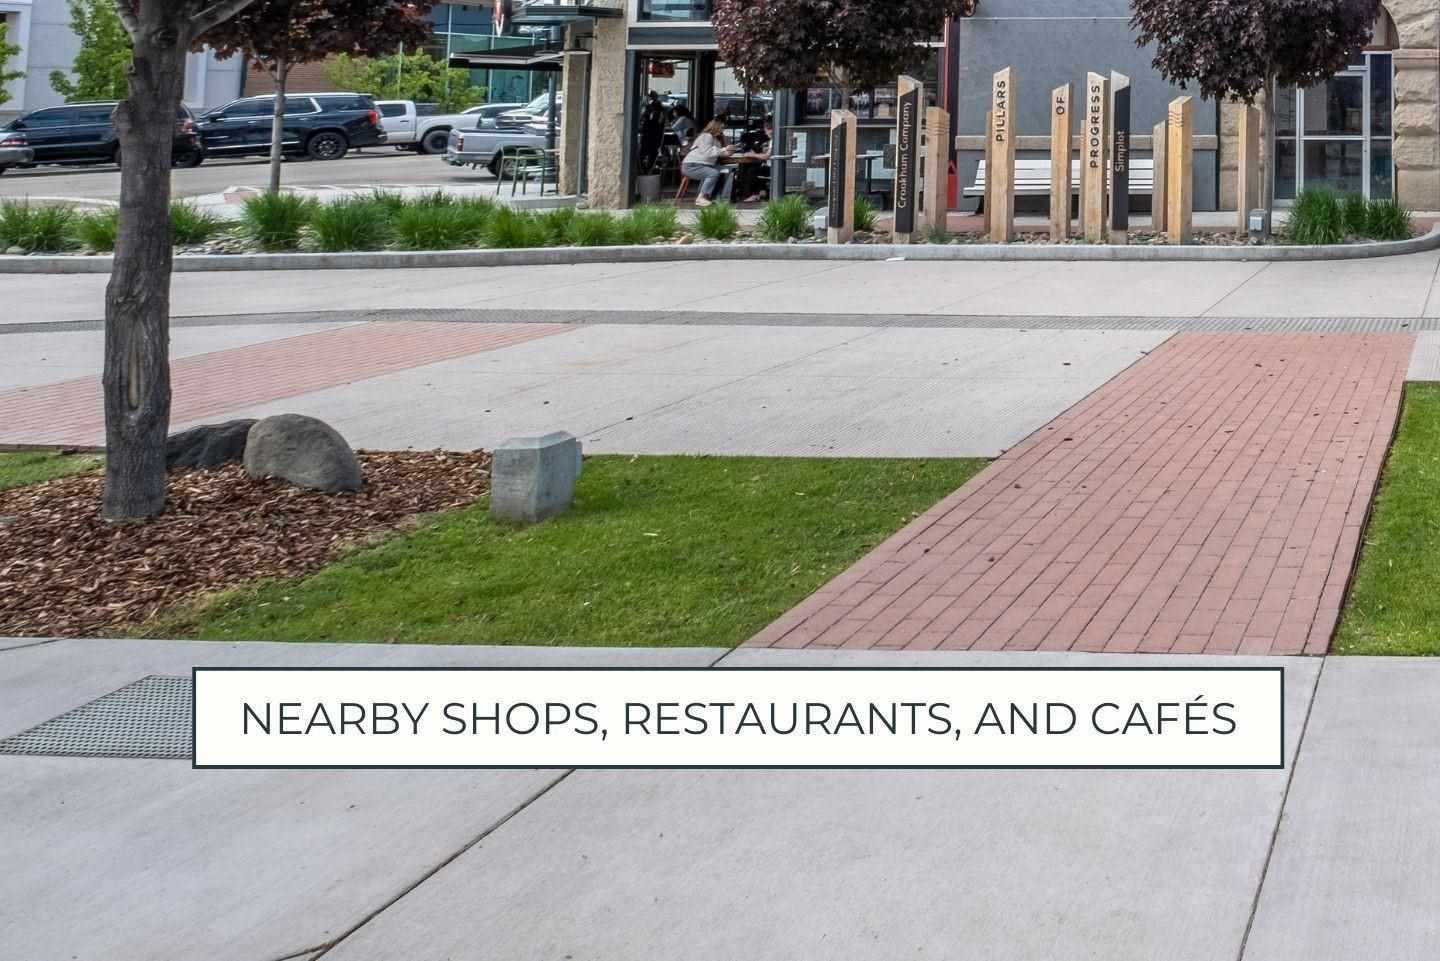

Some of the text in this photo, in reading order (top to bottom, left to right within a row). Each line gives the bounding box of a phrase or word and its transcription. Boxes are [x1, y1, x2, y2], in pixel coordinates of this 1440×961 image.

[995, 80, 1006, 142] PILLARS
[1055, 96, 1065, 115] OF
[1089, 85, 1100, 169] PROGRESS
[897, 100, 913, 209] Crookham Company
[1114, 130, 1127, 173] Simplot
